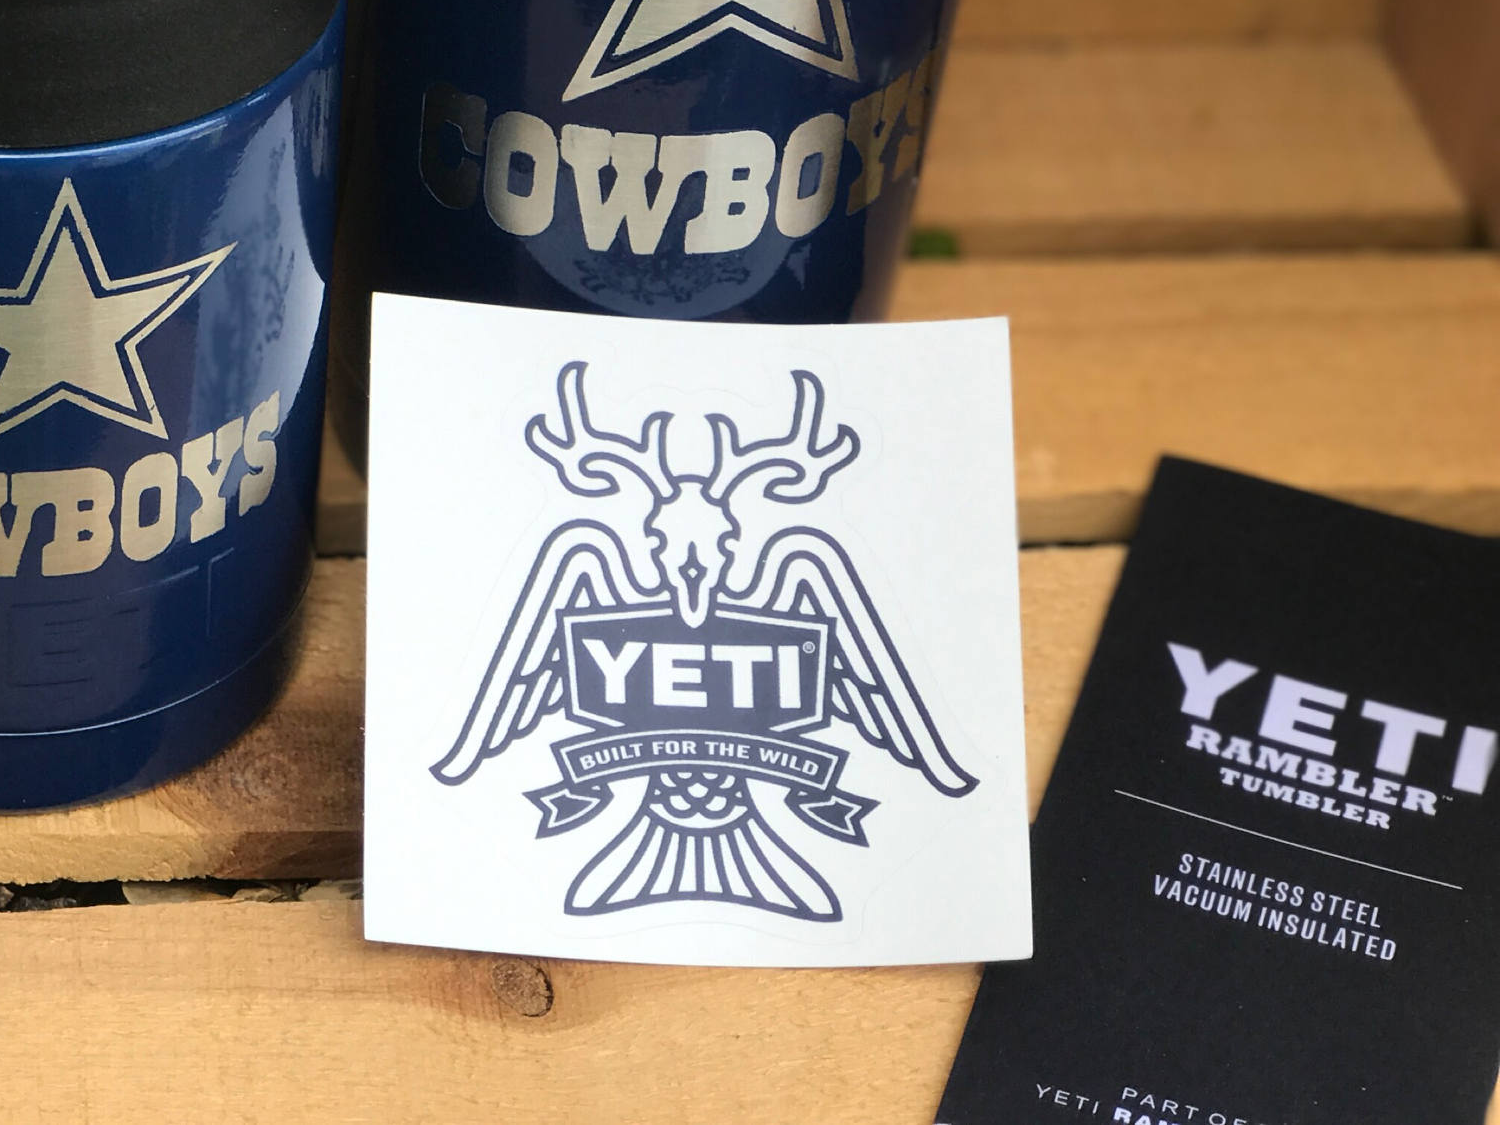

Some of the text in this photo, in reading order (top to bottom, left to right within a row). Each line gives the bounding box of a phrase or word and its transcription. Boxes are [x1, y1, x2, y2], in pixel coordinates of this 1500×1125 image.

[1166, 641, 1498, 796] YETI
[579, 740, 820, 777] BUILT FOR THE WILD
[1219, 766, 1390, 830] TUMBLER
[1154, 874, 1397, 962] VACUUM INSULATED
[1178, 853, 1381, 929] STAINLESS STEEL
[1036, 1083, 1100, 1115] YETI
[1121, 1086, 1200, 1120] PART
